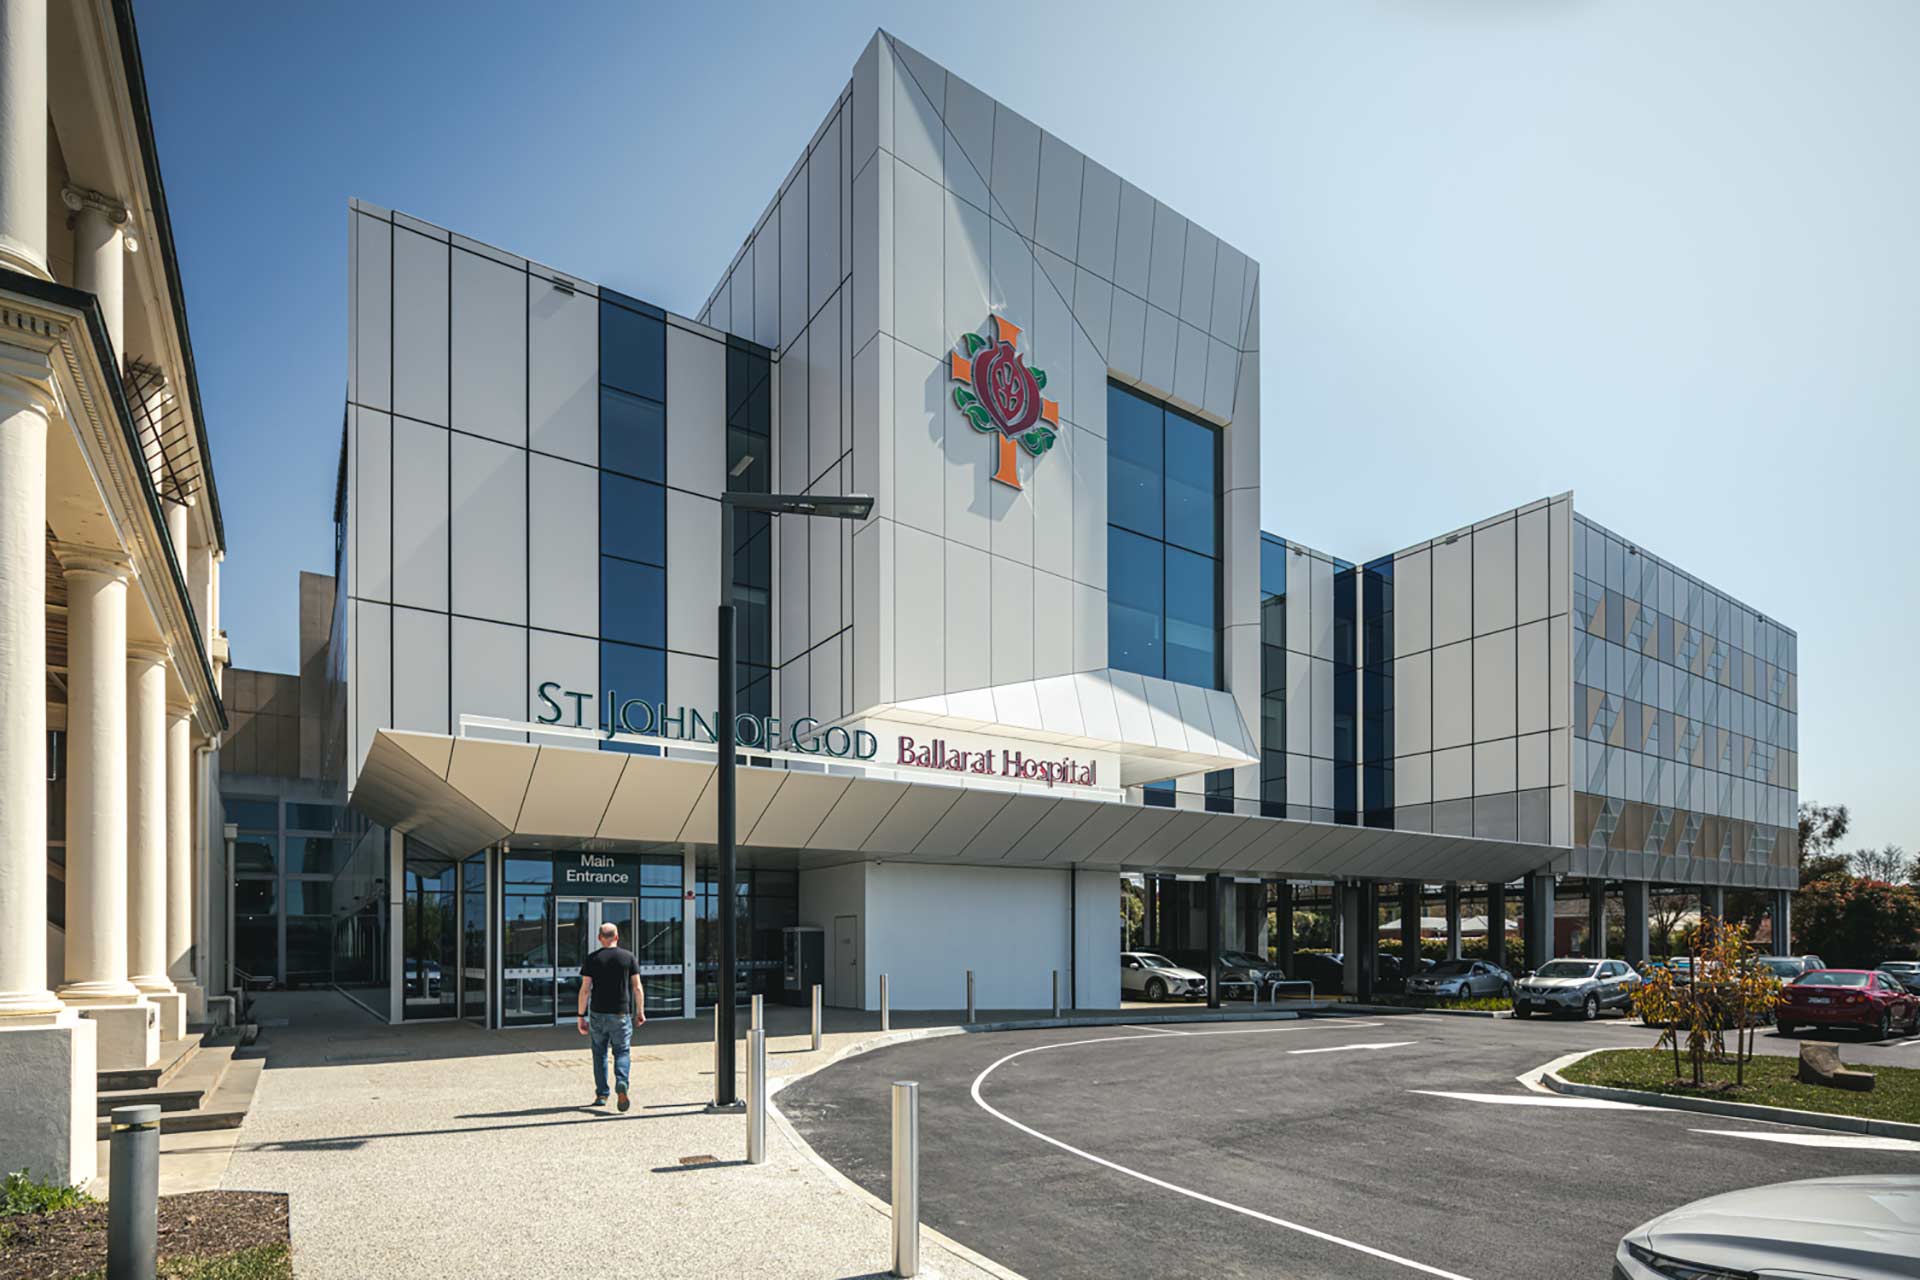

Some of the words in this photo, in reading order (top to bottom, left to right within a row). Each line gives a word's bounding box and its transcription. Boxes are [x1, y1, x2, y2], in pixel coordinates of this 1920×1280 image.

[537, 682, 593, 726] ST
[607, 690, 719, 743] JOHN
[735, 713, 781, 752] OF
[791, 717, 878, 759] GOD
[897, 736, 995, 774] Ballarat
[1002, 750, 1097, 788] Hospital
[581, 854, 615, 867] Main
[566, 869, 629, 883] Entrance
